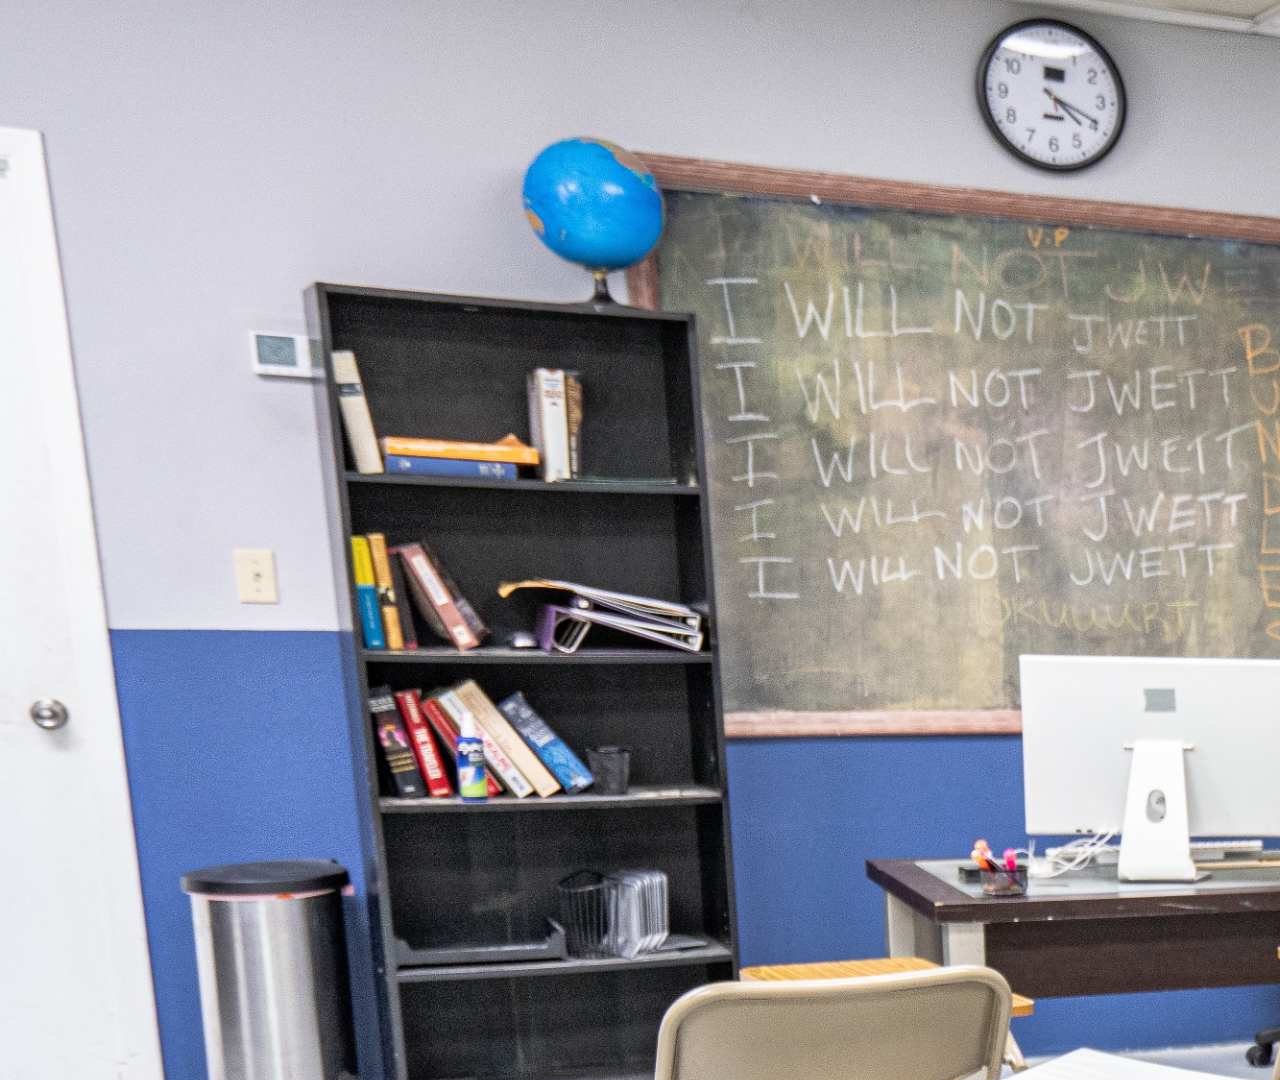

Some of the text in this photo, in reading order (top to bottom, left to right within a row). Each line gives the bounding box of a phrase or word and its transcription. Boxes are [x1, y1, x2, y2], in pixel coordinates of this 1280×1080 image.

[705, 278, 764, 345] I
[783, 280, 935, 342] WILL
[953, 288, 1050, 344] NOT
[715, 358, 1238, 424] I WILL NOT JWETT
[726, 433, 779, 488] I
[811, 431, 932, 487] WILL
[954, 428, 1050, 480] NOT
[734, 488, 1249, 542] I WILL NOT JWETT
[738, 541, 1237, 599] I WILL NOT JWETT
